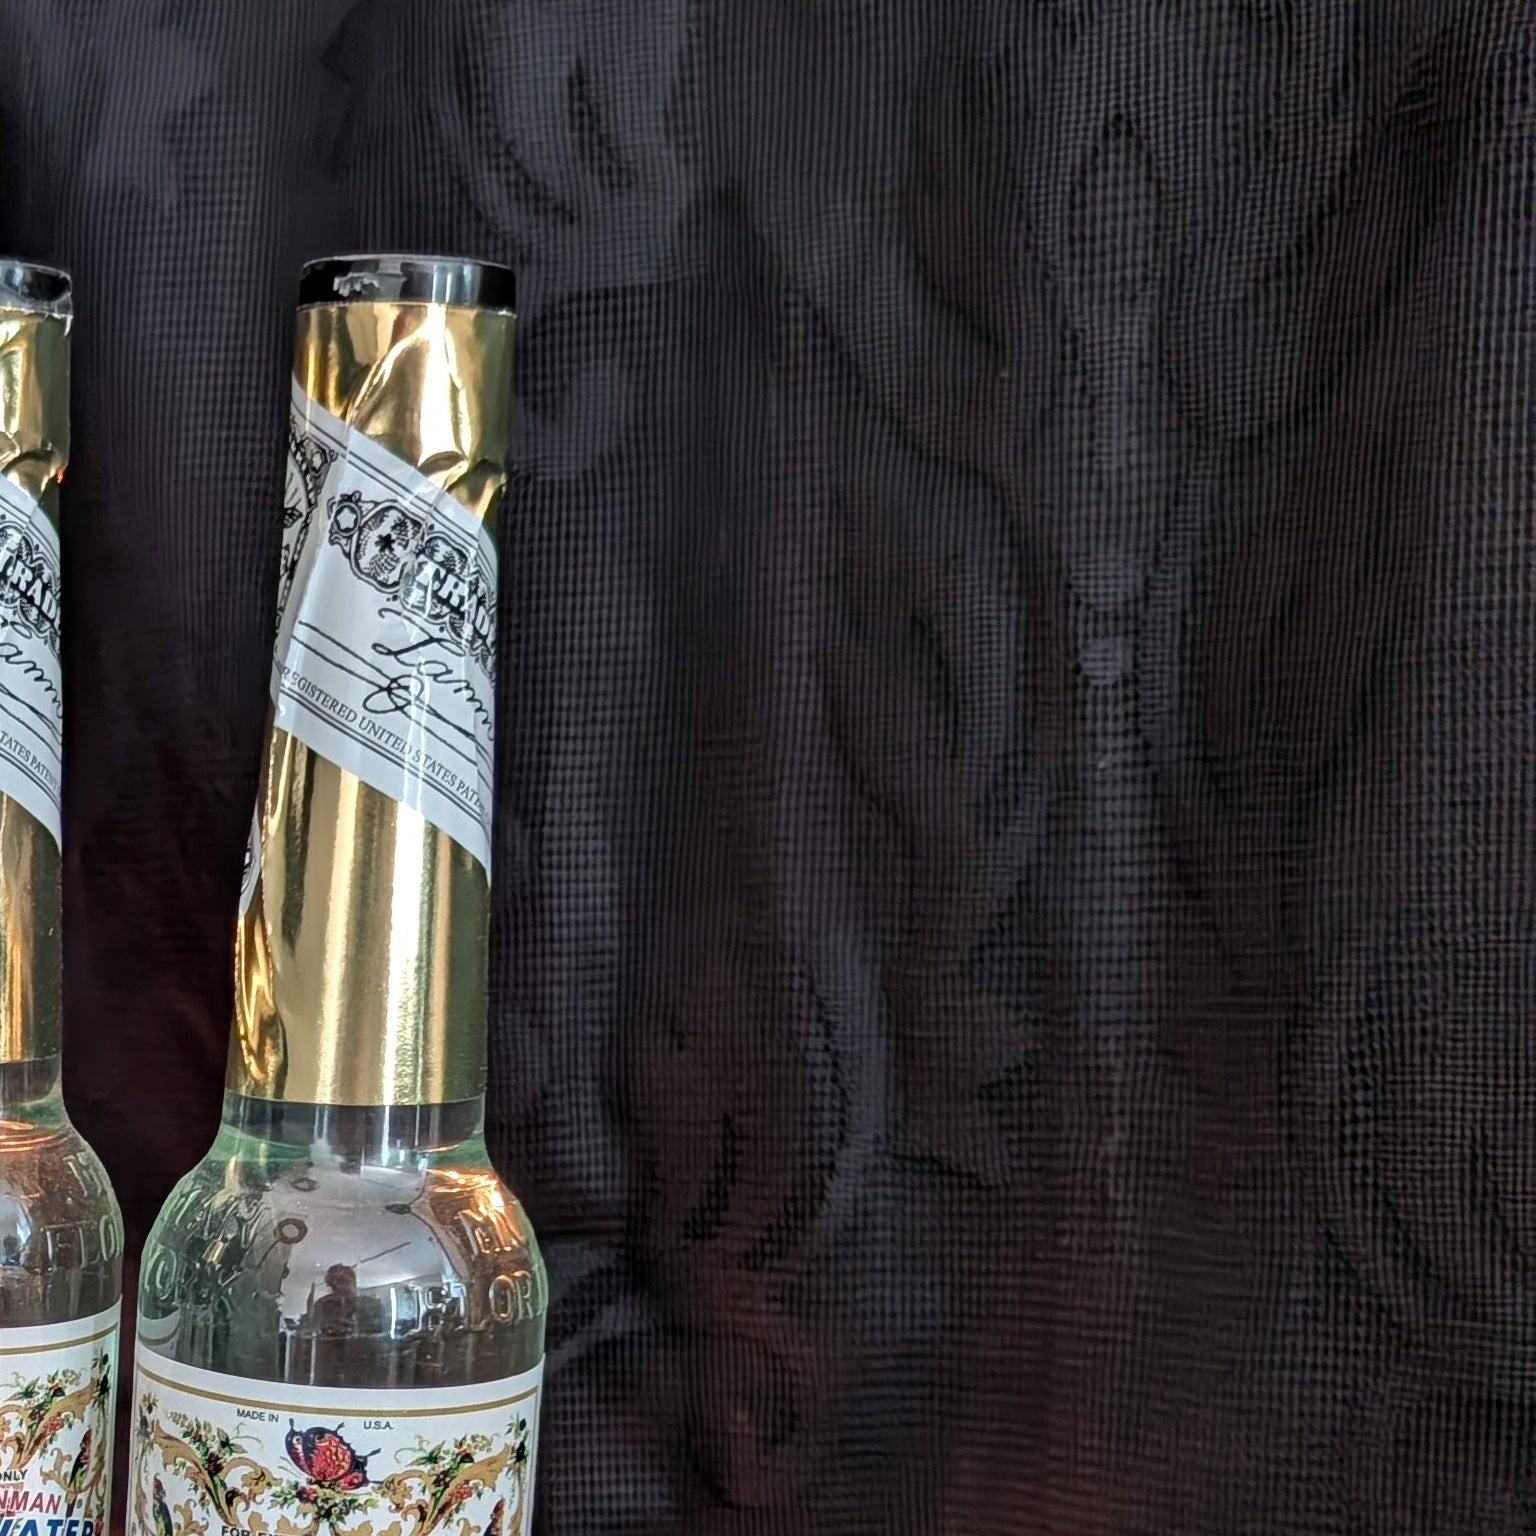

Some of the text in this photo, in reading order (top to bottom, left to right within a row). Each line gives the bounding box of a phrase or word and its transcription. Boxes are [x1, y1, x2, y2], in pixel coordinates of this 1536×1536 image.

[414, 554, 495, 652] TRAD
[282, 666, 357, 723] REGISTERED
[359, 716, 413, 756] UNITED
[412, 749, 457, 788] STATES
[237, 1408, 279, 1423] MADE IN
